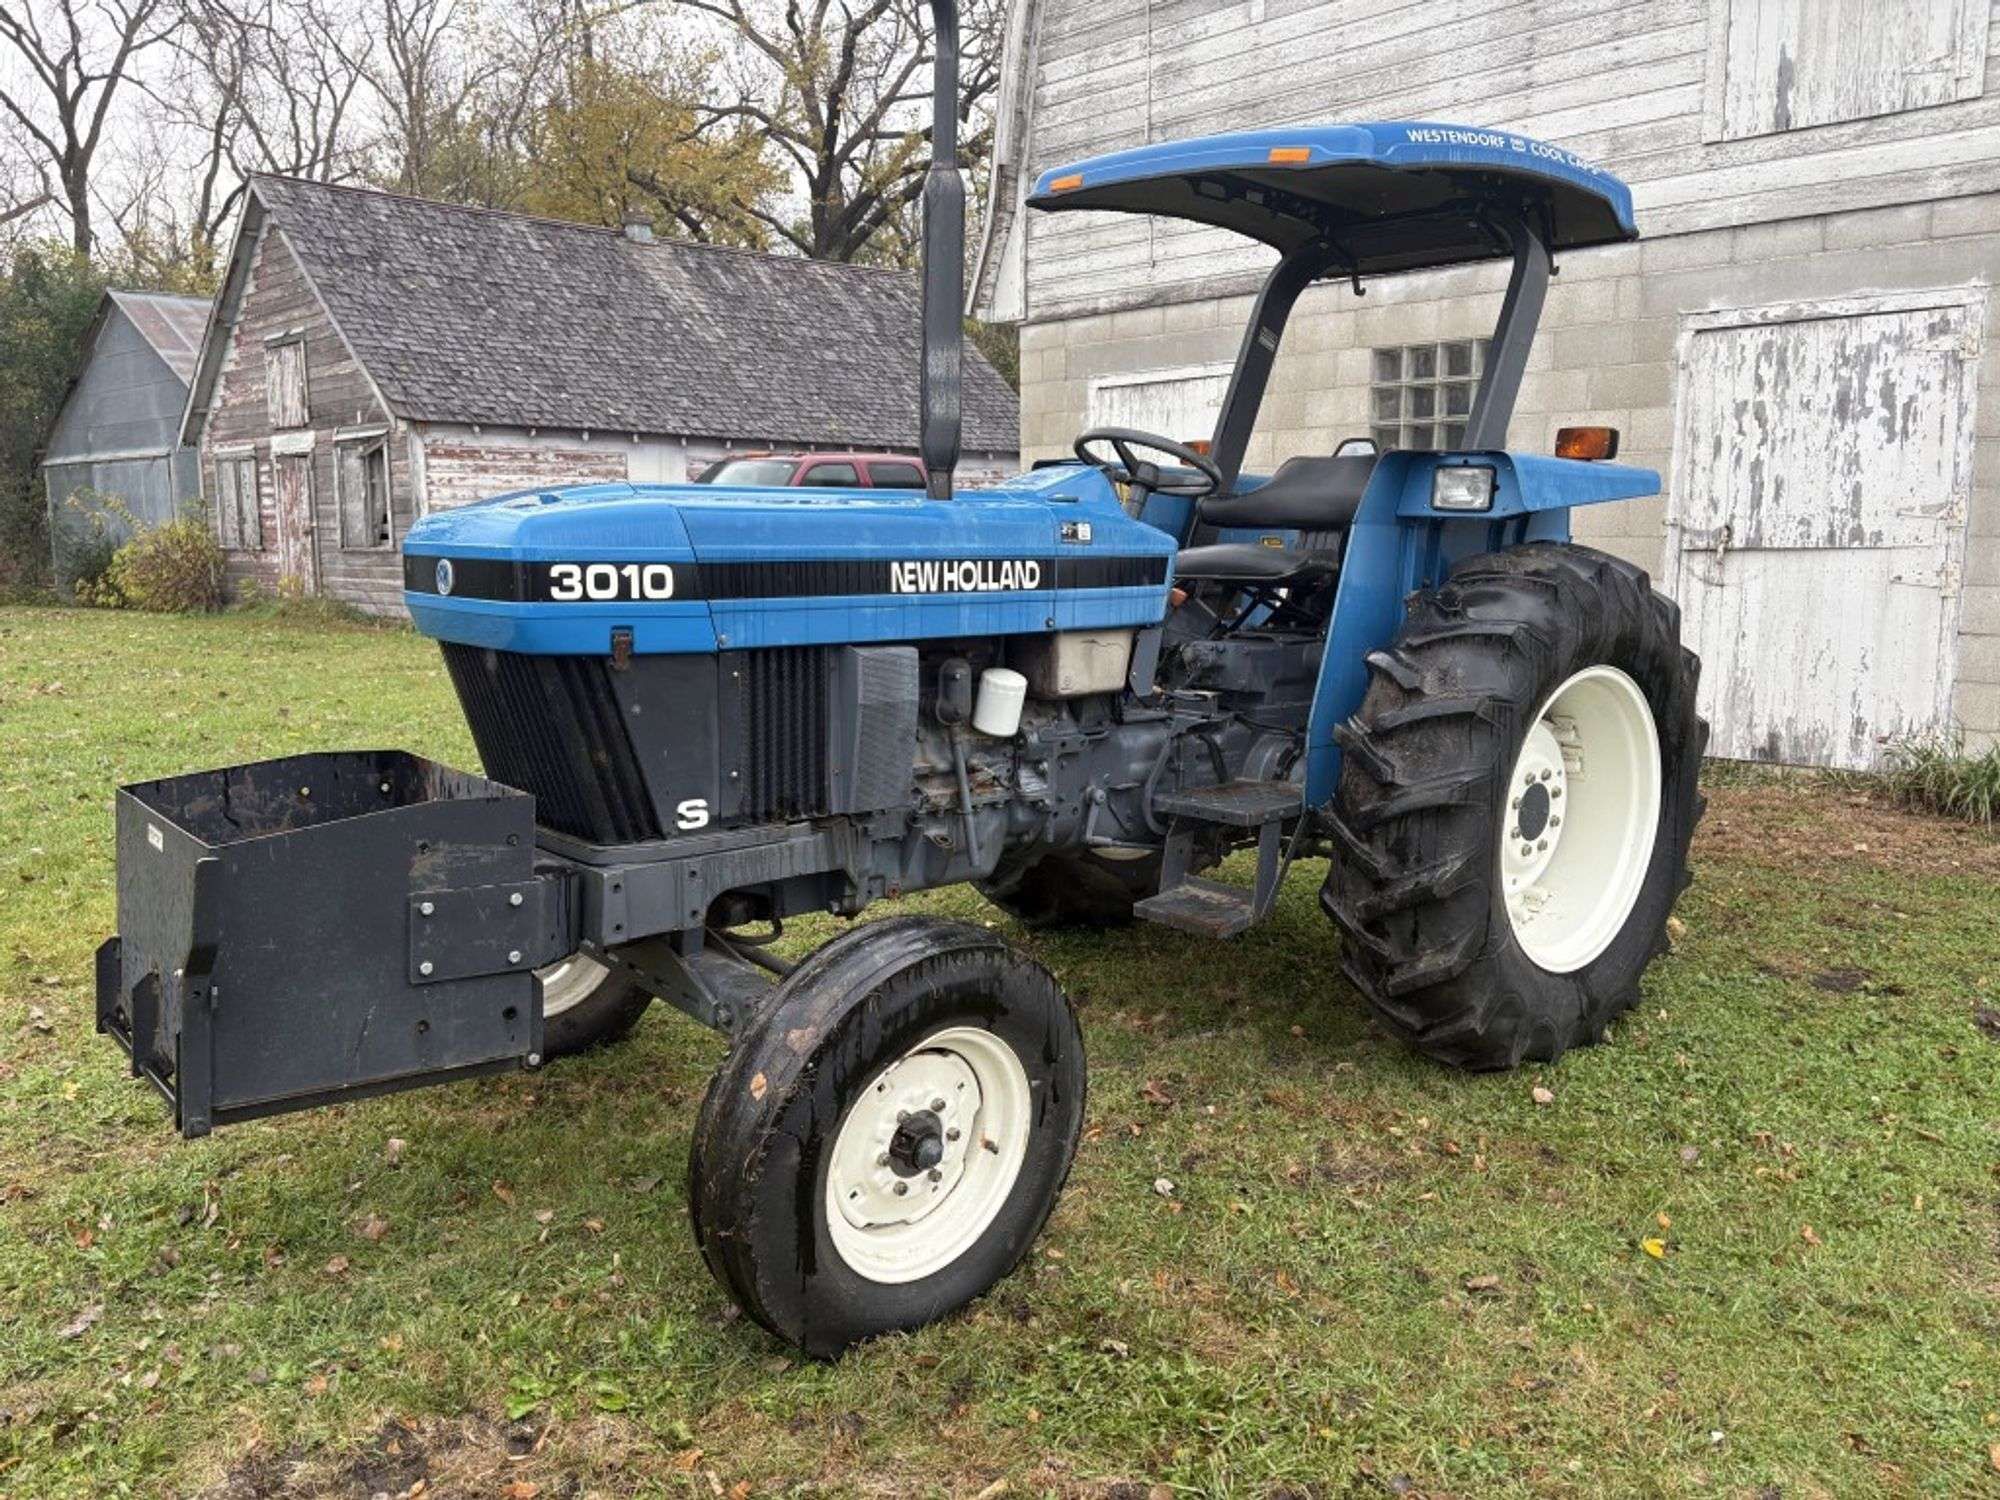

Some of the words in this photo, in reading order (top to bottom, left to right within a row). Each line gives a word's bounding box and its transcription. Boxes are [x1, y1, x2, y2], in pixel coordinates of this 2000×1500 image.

[1406, 129, 1505, 148] WESTENDORF
[1530, 142, 1566, 163] COOL
[550, 564, 673, 600] 3010
[890, 562, 939, 593] NEW
[943, 560, 1041, 591] HOLLAND
[677, 798, 709, 830] S
